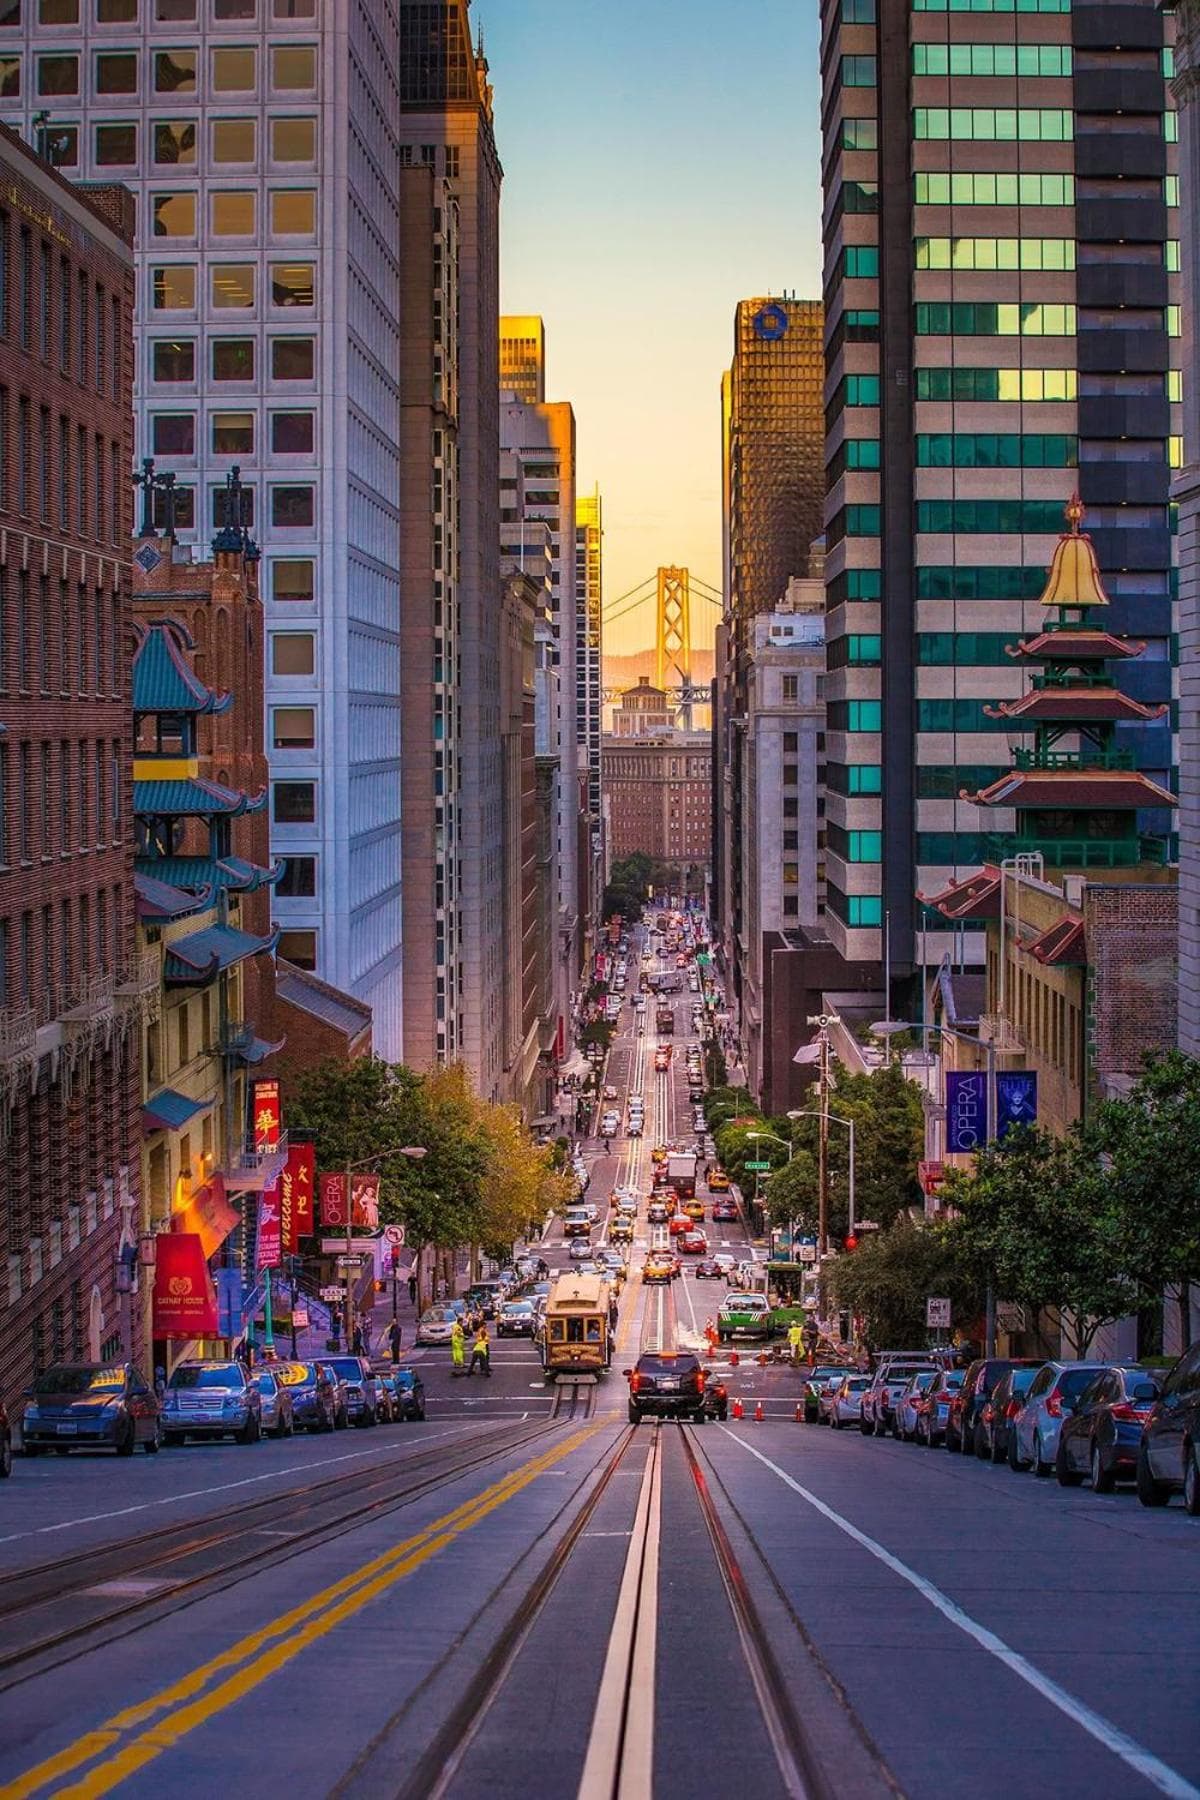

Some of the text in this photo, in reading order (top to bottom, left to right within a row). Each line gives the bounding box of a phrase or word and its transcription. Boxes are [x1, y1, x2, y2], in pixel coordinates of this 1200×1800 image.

[957, 1076, 978, 1149] OPERA
[281, 1172, 294, 1247] welcome
[327, 1175, 341, 1224] OPERA
